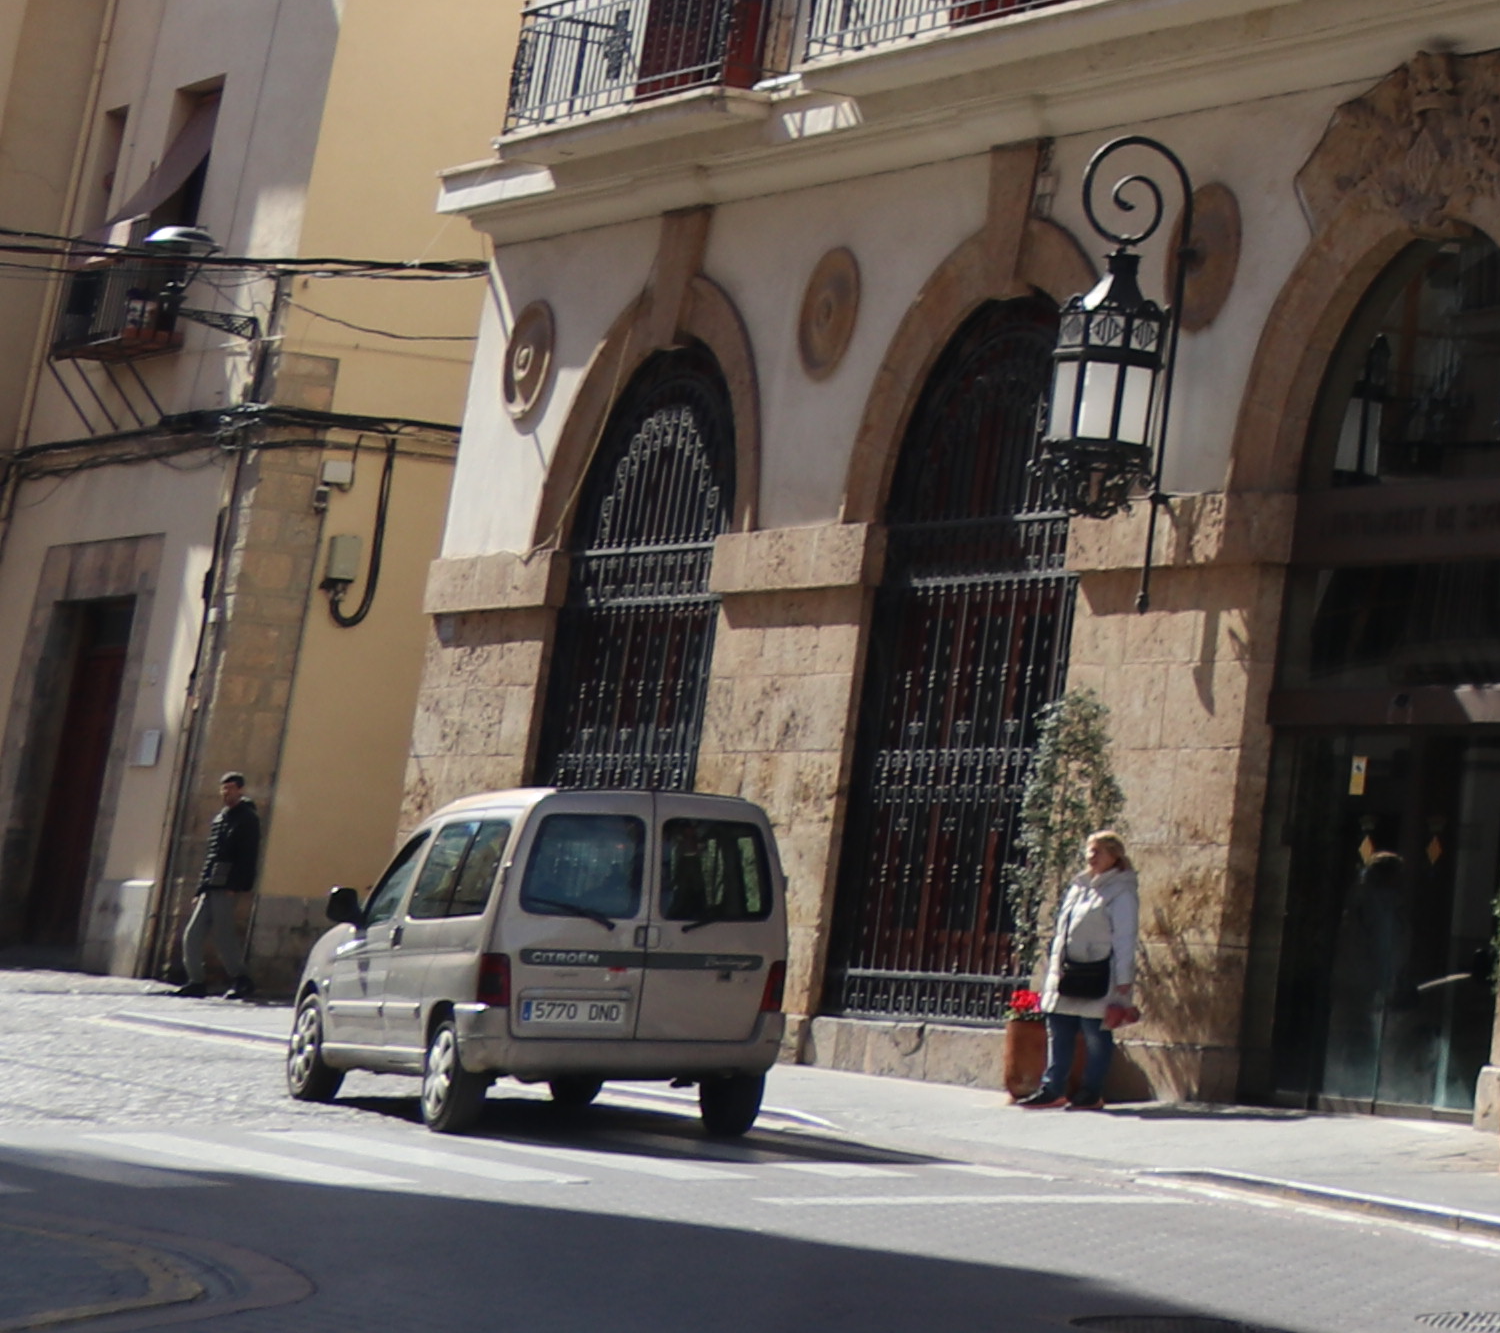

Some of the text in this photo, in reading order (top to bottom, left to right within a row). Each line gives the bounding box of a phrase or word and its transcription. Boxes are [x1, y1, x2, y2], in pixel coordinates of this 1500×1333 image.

[531, 951, 600, 965] CITROËN
[535, 1000, 620, 1022] 5770 DND
